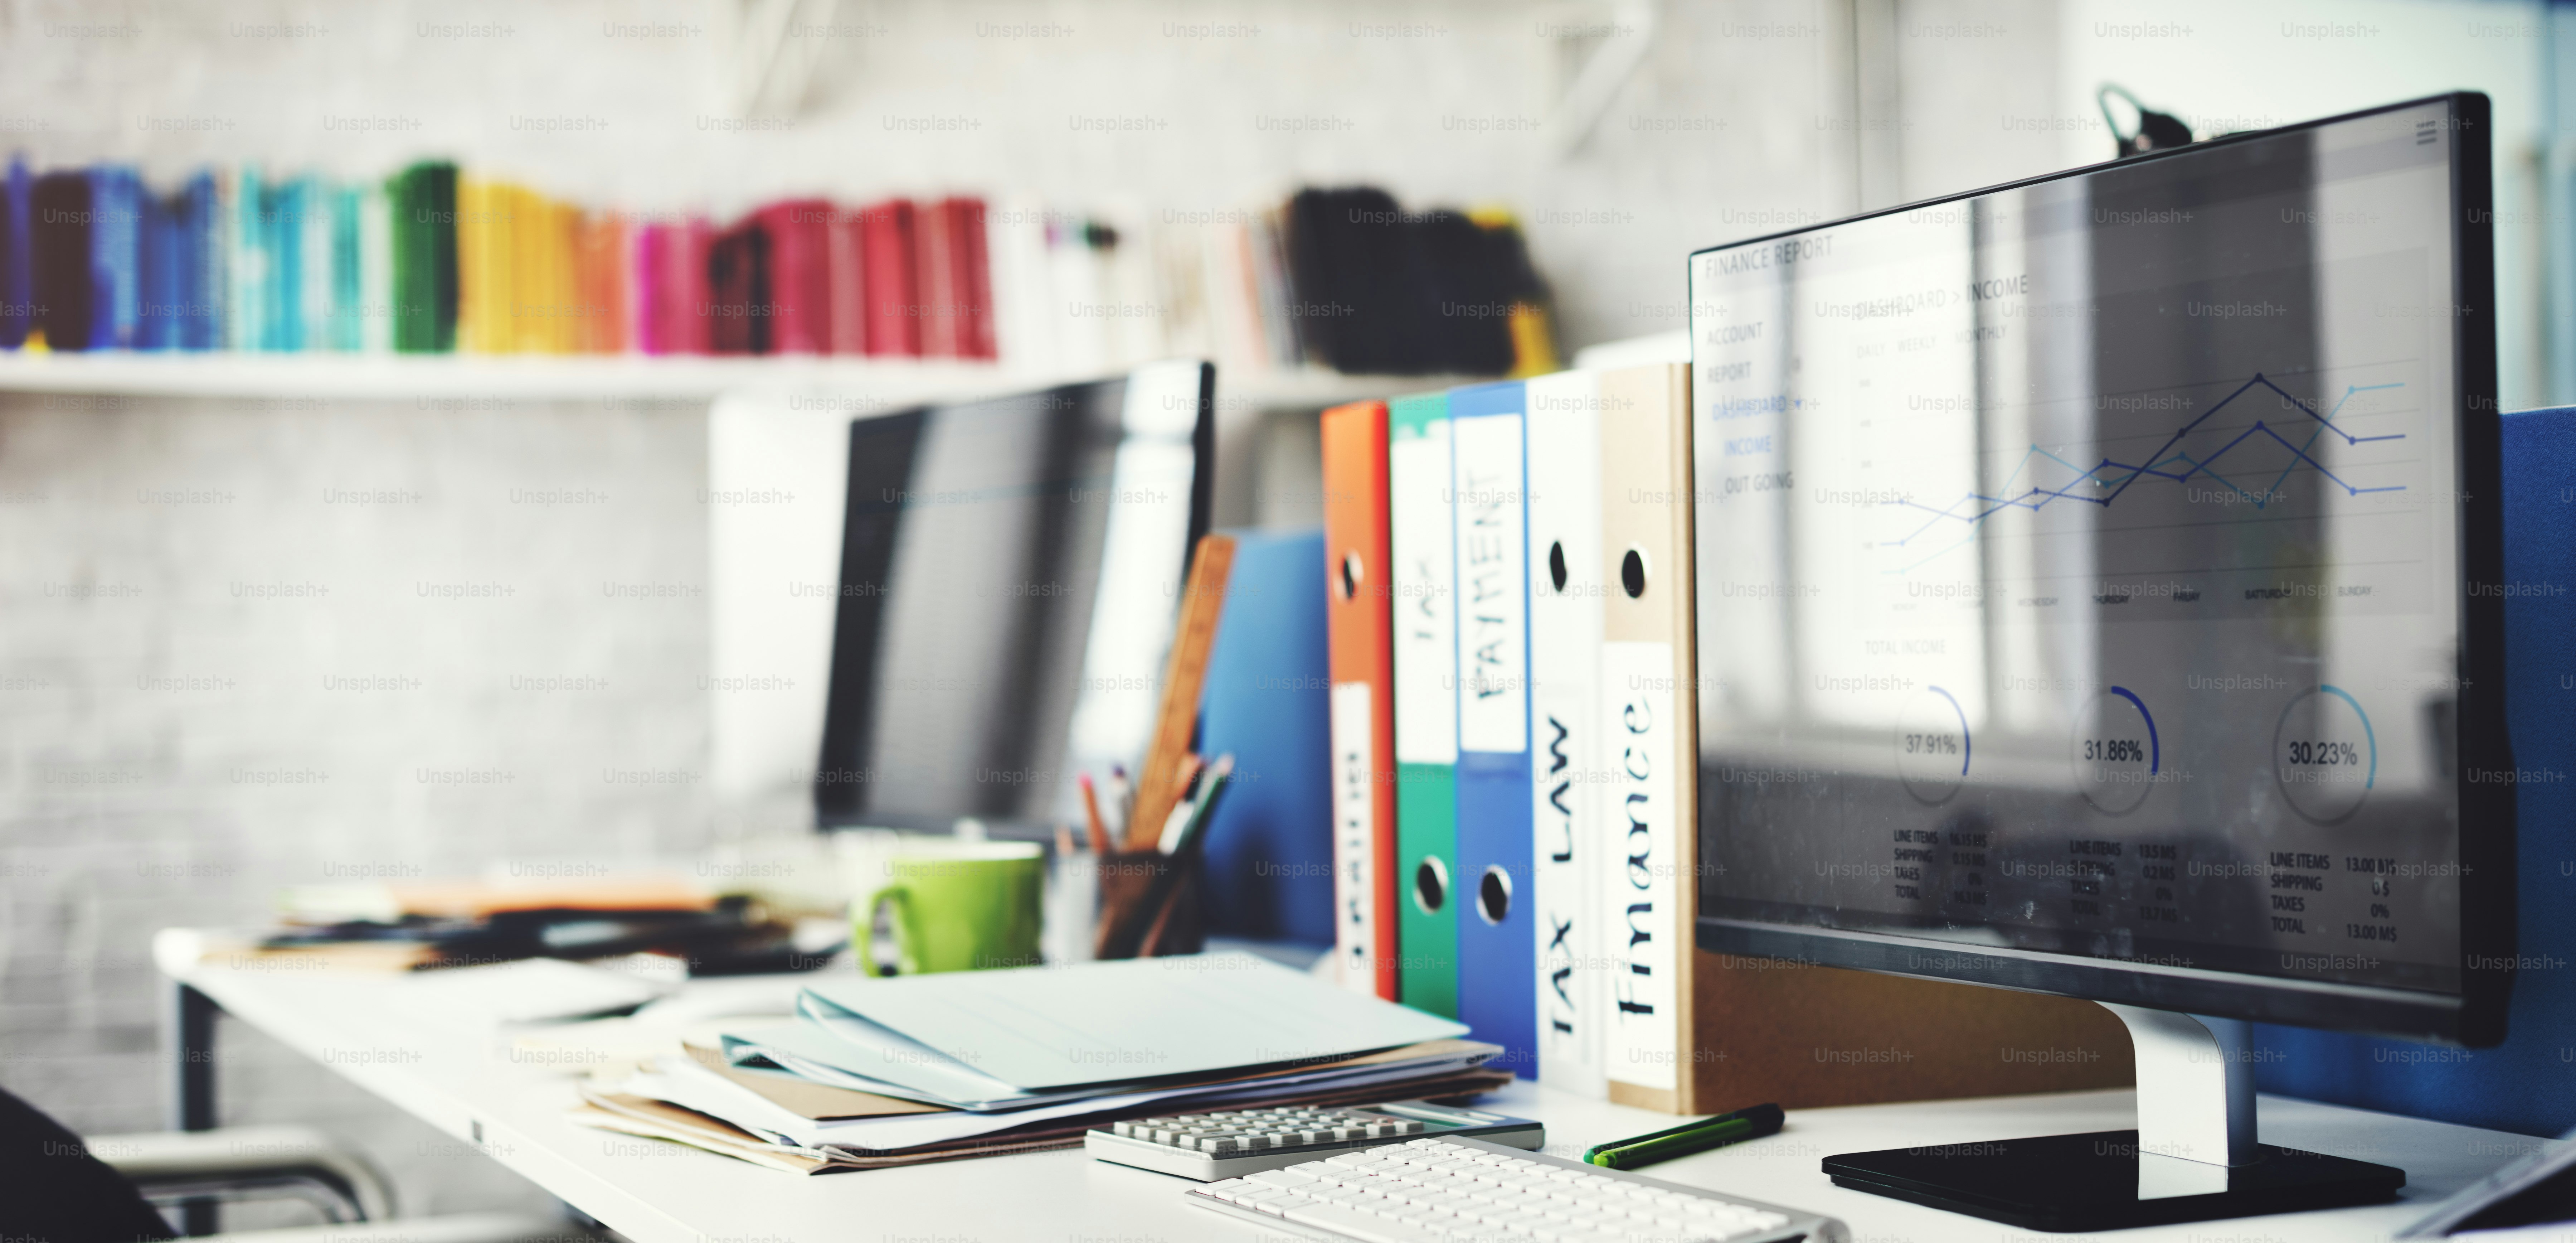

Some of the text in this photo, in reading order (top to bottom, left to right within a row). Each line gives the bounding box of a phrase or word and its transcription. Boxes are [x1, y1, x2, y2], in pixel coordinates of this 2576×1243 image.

[1706, 234, 1833, 278] FINANCE REPORT
[1856, 289, 1946, 320] DASHBOARD
[1967, 275, 2028, 302] INCOME
[1707, 321, 1763, 345] ACCOUNT
[1857, 325, 2007, 359] DAILY WEEKLY MONTHLY
[1707, 361, 1751, 383] REPORT
[1725, 435, 1772, 457] INCOME
[1725, 471, 1794, 494] OUT GOING
[1467, 469, 1505, 700] PAYMENT
[1865, 639, 1946, 655] TOTAL INCOME
[1906, 734, 1956, 754] 37.91%
[2085, 740, 2143, 761] 31.86%
[2289, 741, 2357, 765] 30.23%
[1894, 829, 1912, 842] LINE
[1913, 830, 1939, 845] ITEMS
[1615, 696, 1654, 1025] Finance
[1894, 847, 1933, 863] SHIPPING
[2069, 840, 2091, 855] LINE
[2092, 840, 2121, 856] ITEMS
[2139, 844, 2159, 859] 13.5
[2270, 851, 2295, 868] LINE
[2296, 852, 2330, 870] ITEMS
[2346, 857, 2376, 873] 13.00
[1548, 714, 1575, 1044] TAX LAW
[2070, 879, 2100, 895] TAXES
[2270, 873, 2323, 892] SHIPPING
[1894, 884, 1921, 900] TOTAL
[2070, 899, 2101, 916] TOTAL
[2271, 895, 2390, 919] TAXES 0%
[2270, 916, 2306, 934] TOTAL
[2346, 923, 2377, 939] 13.00
